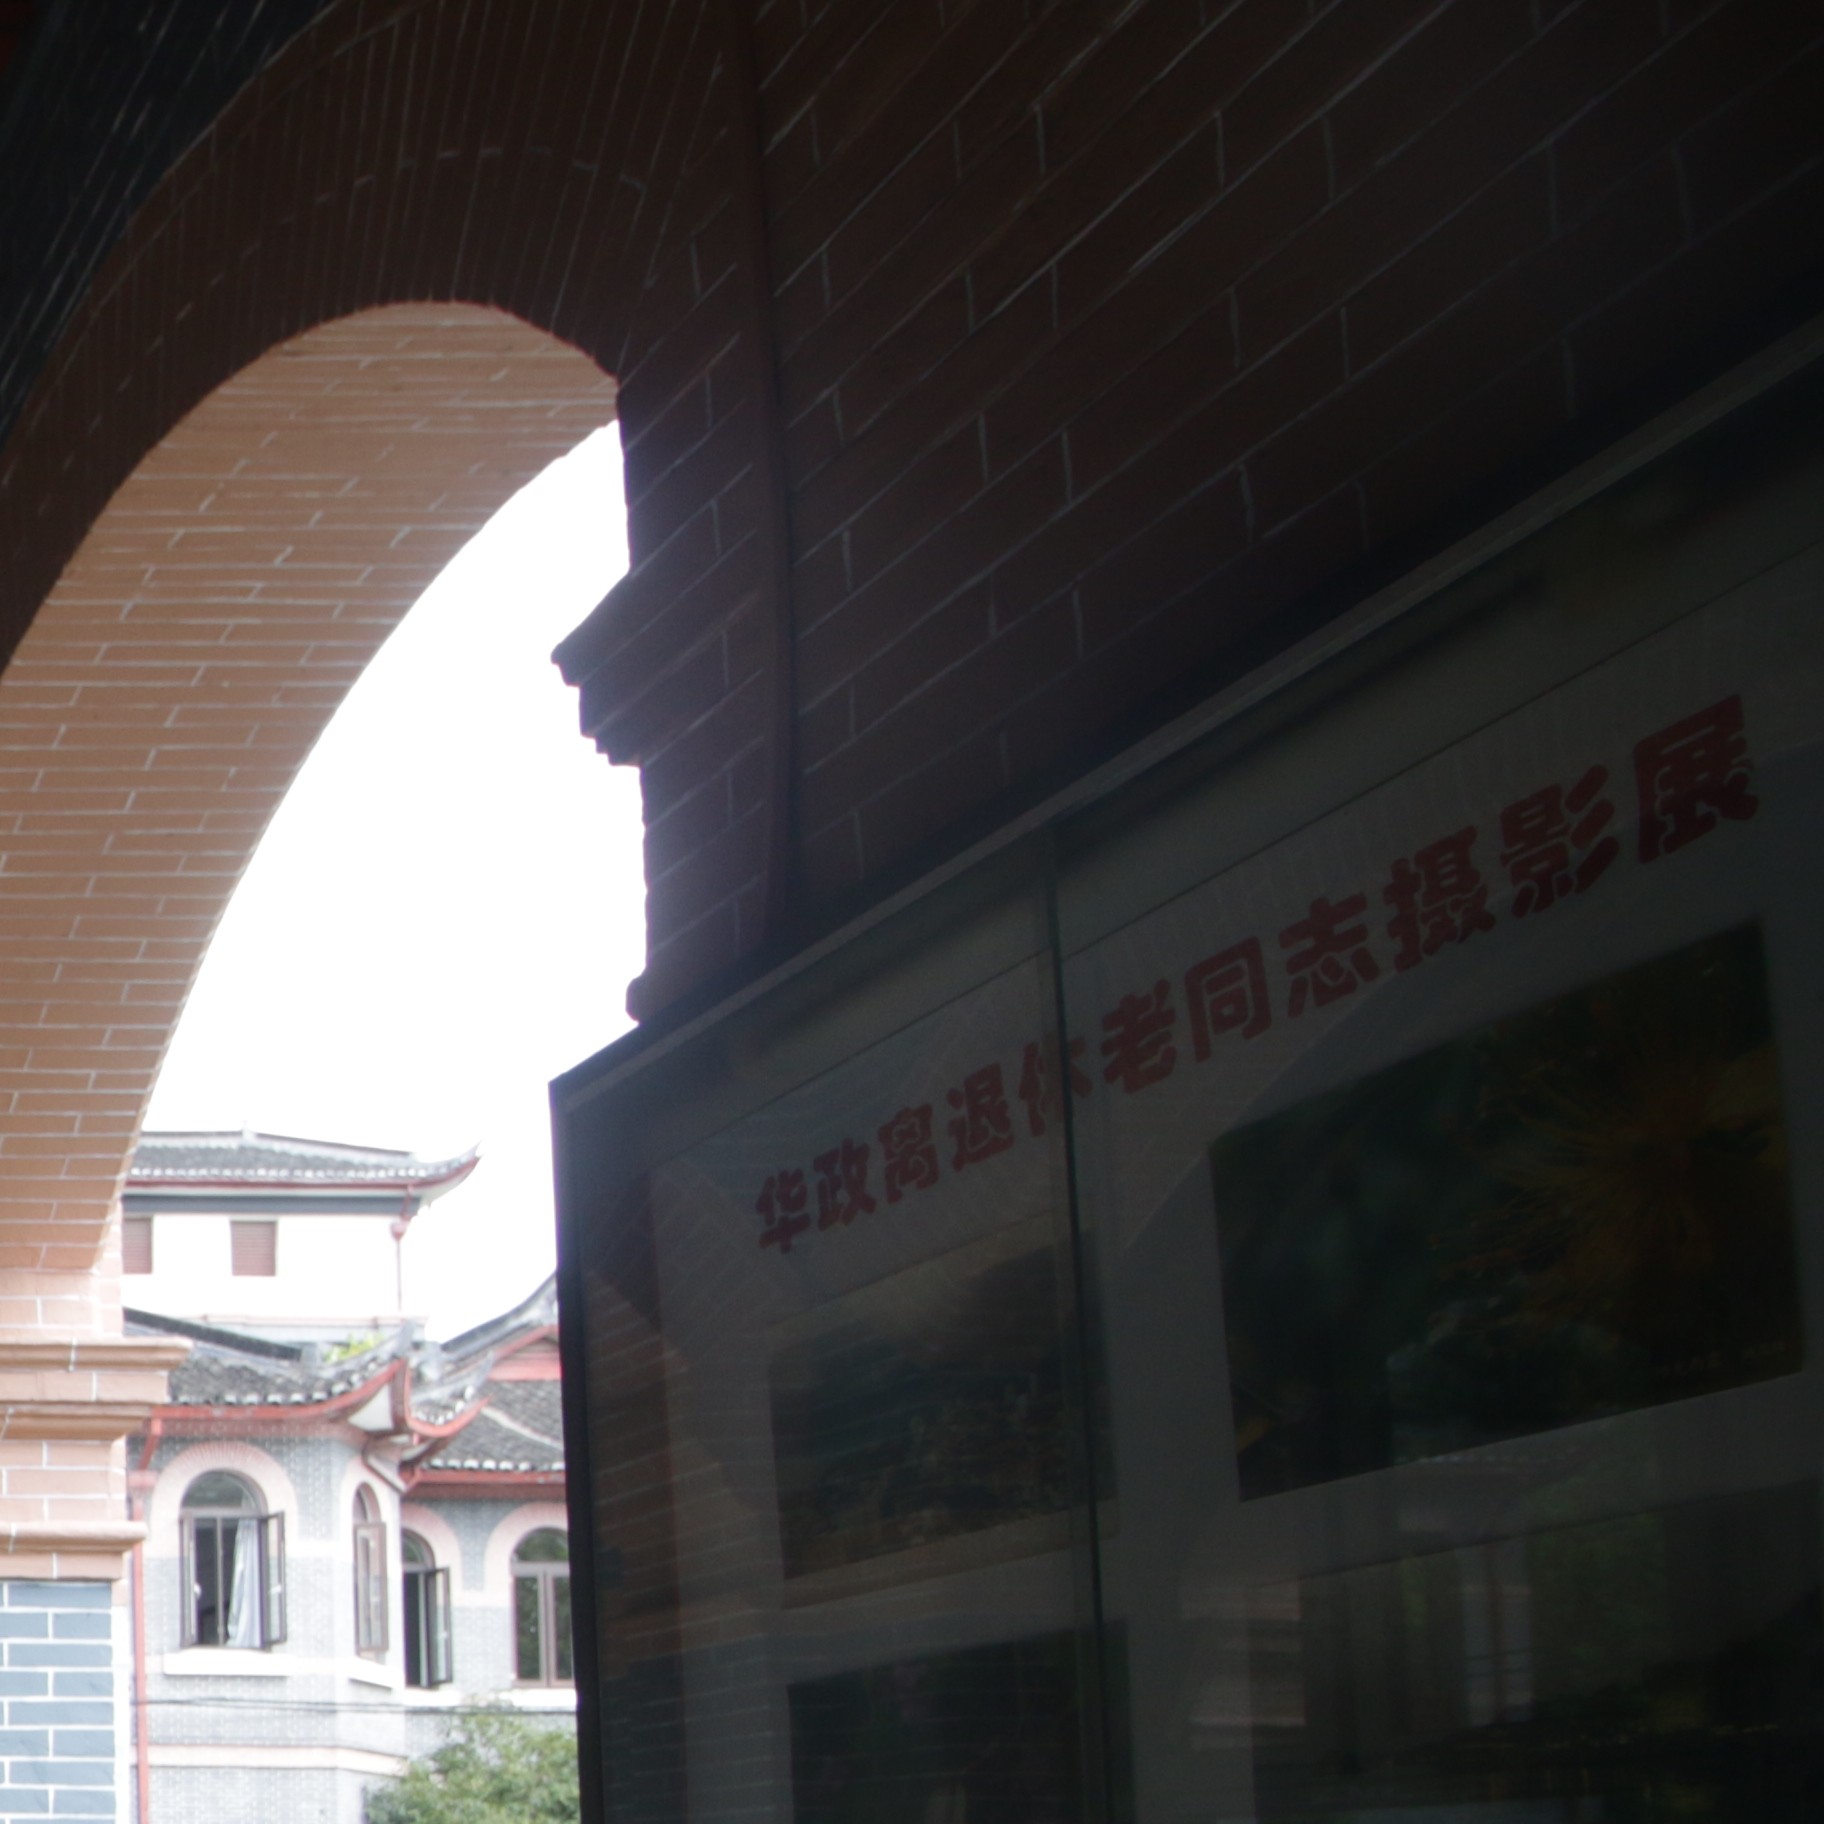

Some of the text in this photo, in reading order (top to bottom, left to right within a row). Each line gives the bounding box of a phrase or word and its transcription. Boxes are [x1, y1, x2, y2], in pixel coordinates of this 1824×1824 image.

[752, 692, 1762, 1256] 华政离退休老同志摄影展
